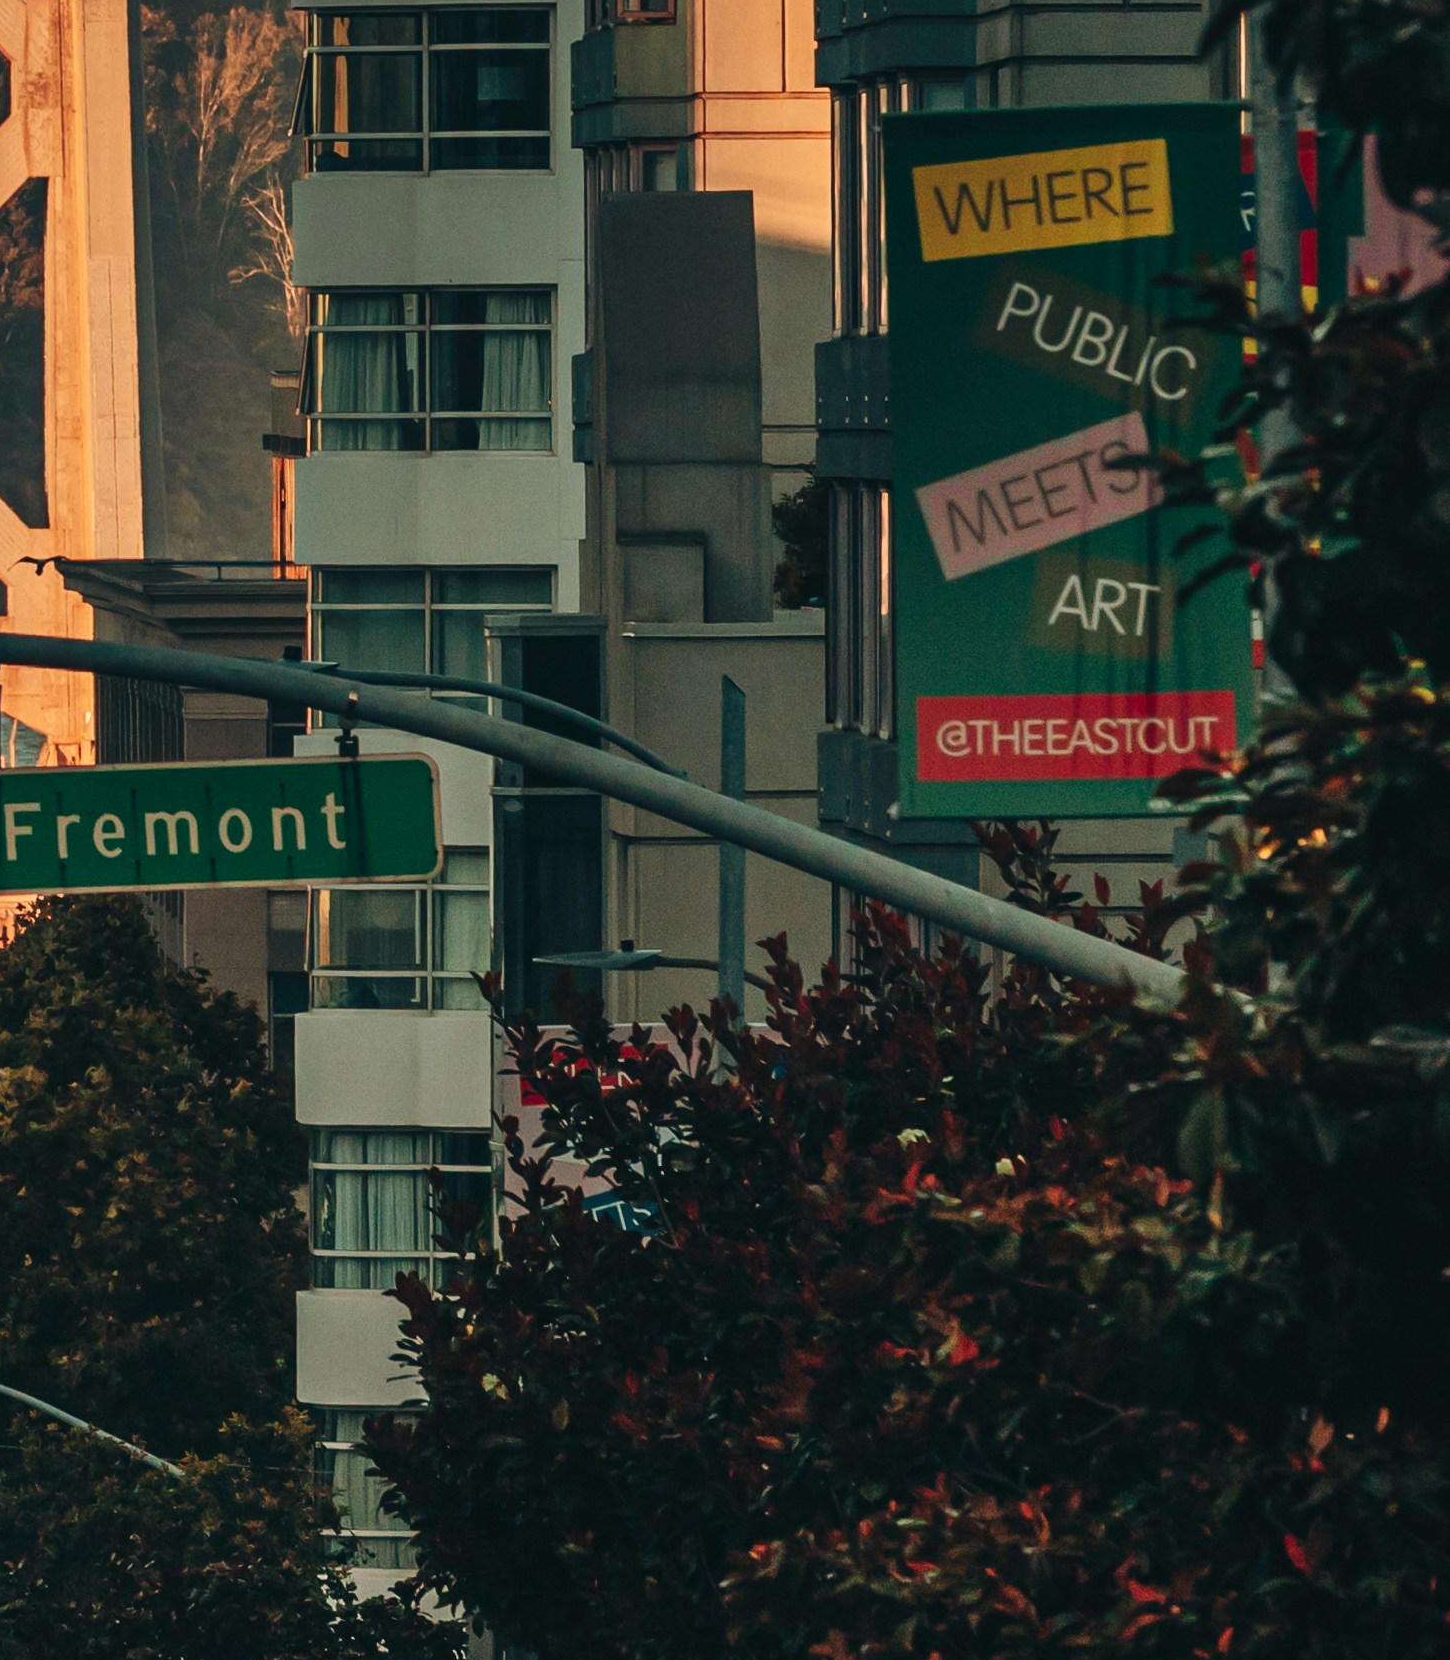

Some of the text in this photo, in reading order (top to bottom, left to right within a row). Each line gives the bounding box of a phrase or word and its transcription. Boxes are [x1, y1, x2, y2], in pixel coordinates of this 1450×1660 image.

[933, 162, 1155, 235] WHERE
[996, 281, 1198, 401] PUBLIC
[945, 440, 1140, 554] MEETS
[1047, 573, 1162, 636] ART
[935, 715, 1220, 757] @THEEASTCUT
[3, 792, 348, 863] Fremont
